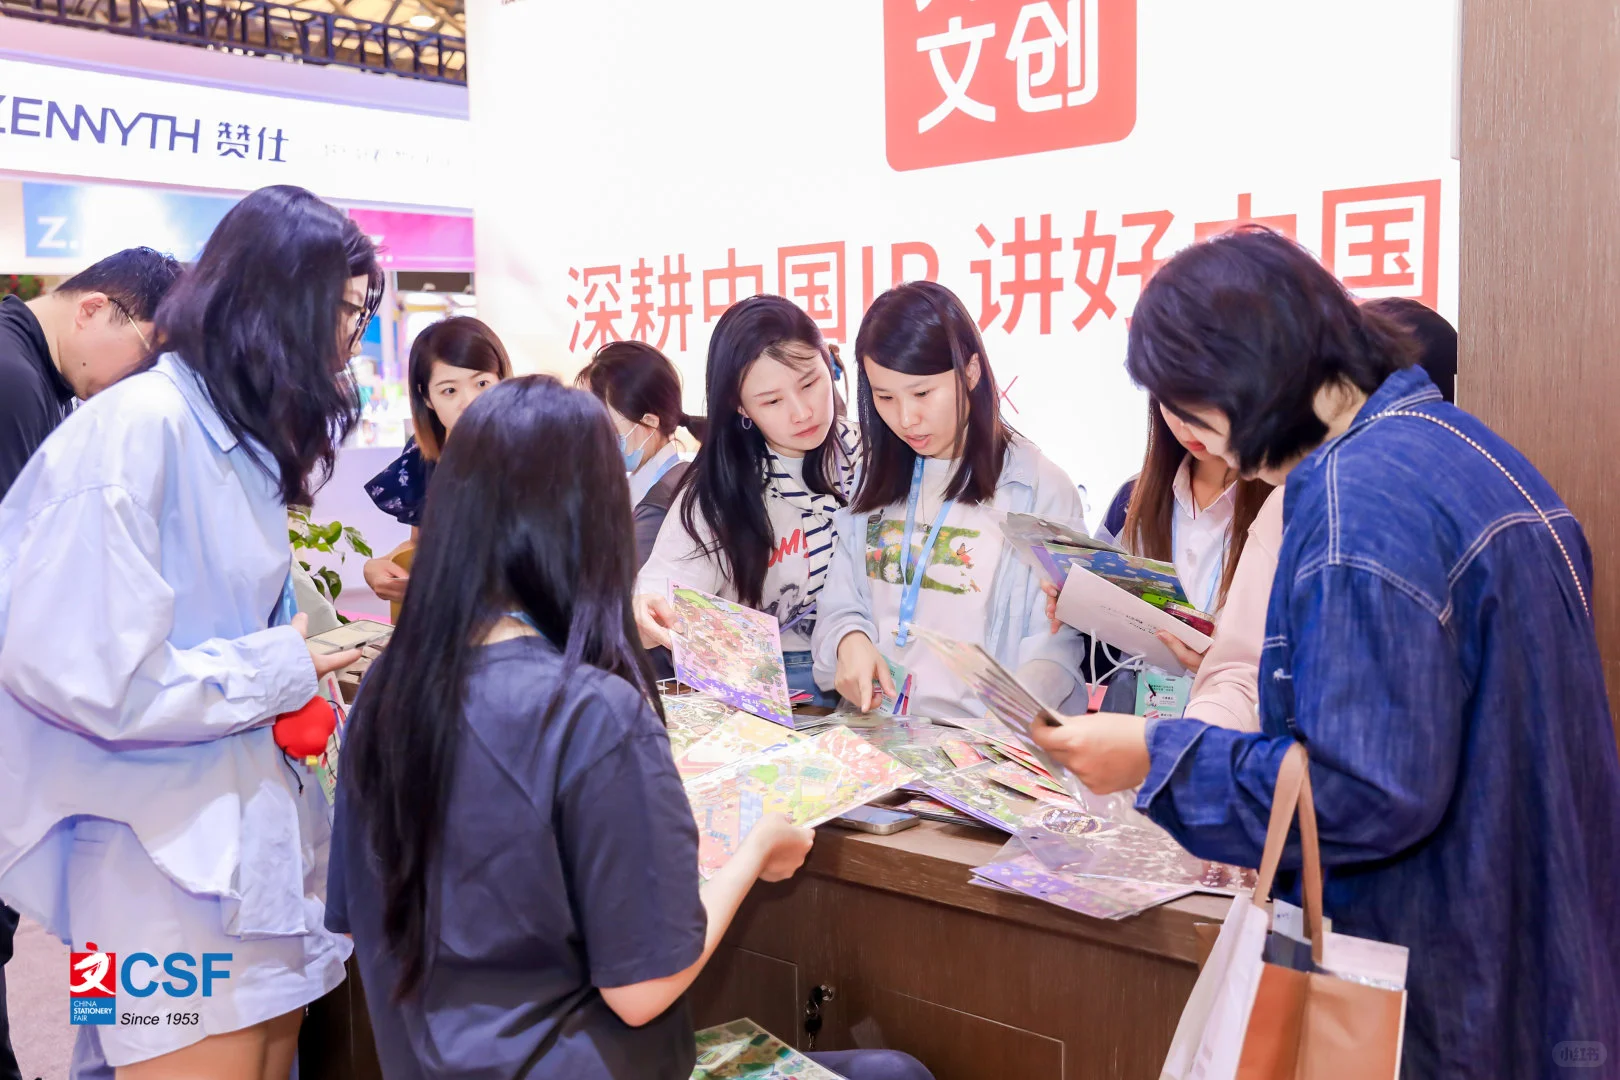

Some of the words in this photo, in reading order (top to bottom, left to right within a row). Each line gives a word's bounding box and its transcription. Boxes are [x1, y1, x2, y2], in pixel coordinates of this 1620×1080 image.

[916, 0, 1099, 135] 文创
[0, 94, 200, 153] ENNYTH
[216, 121, 289, 162] 赞仕
